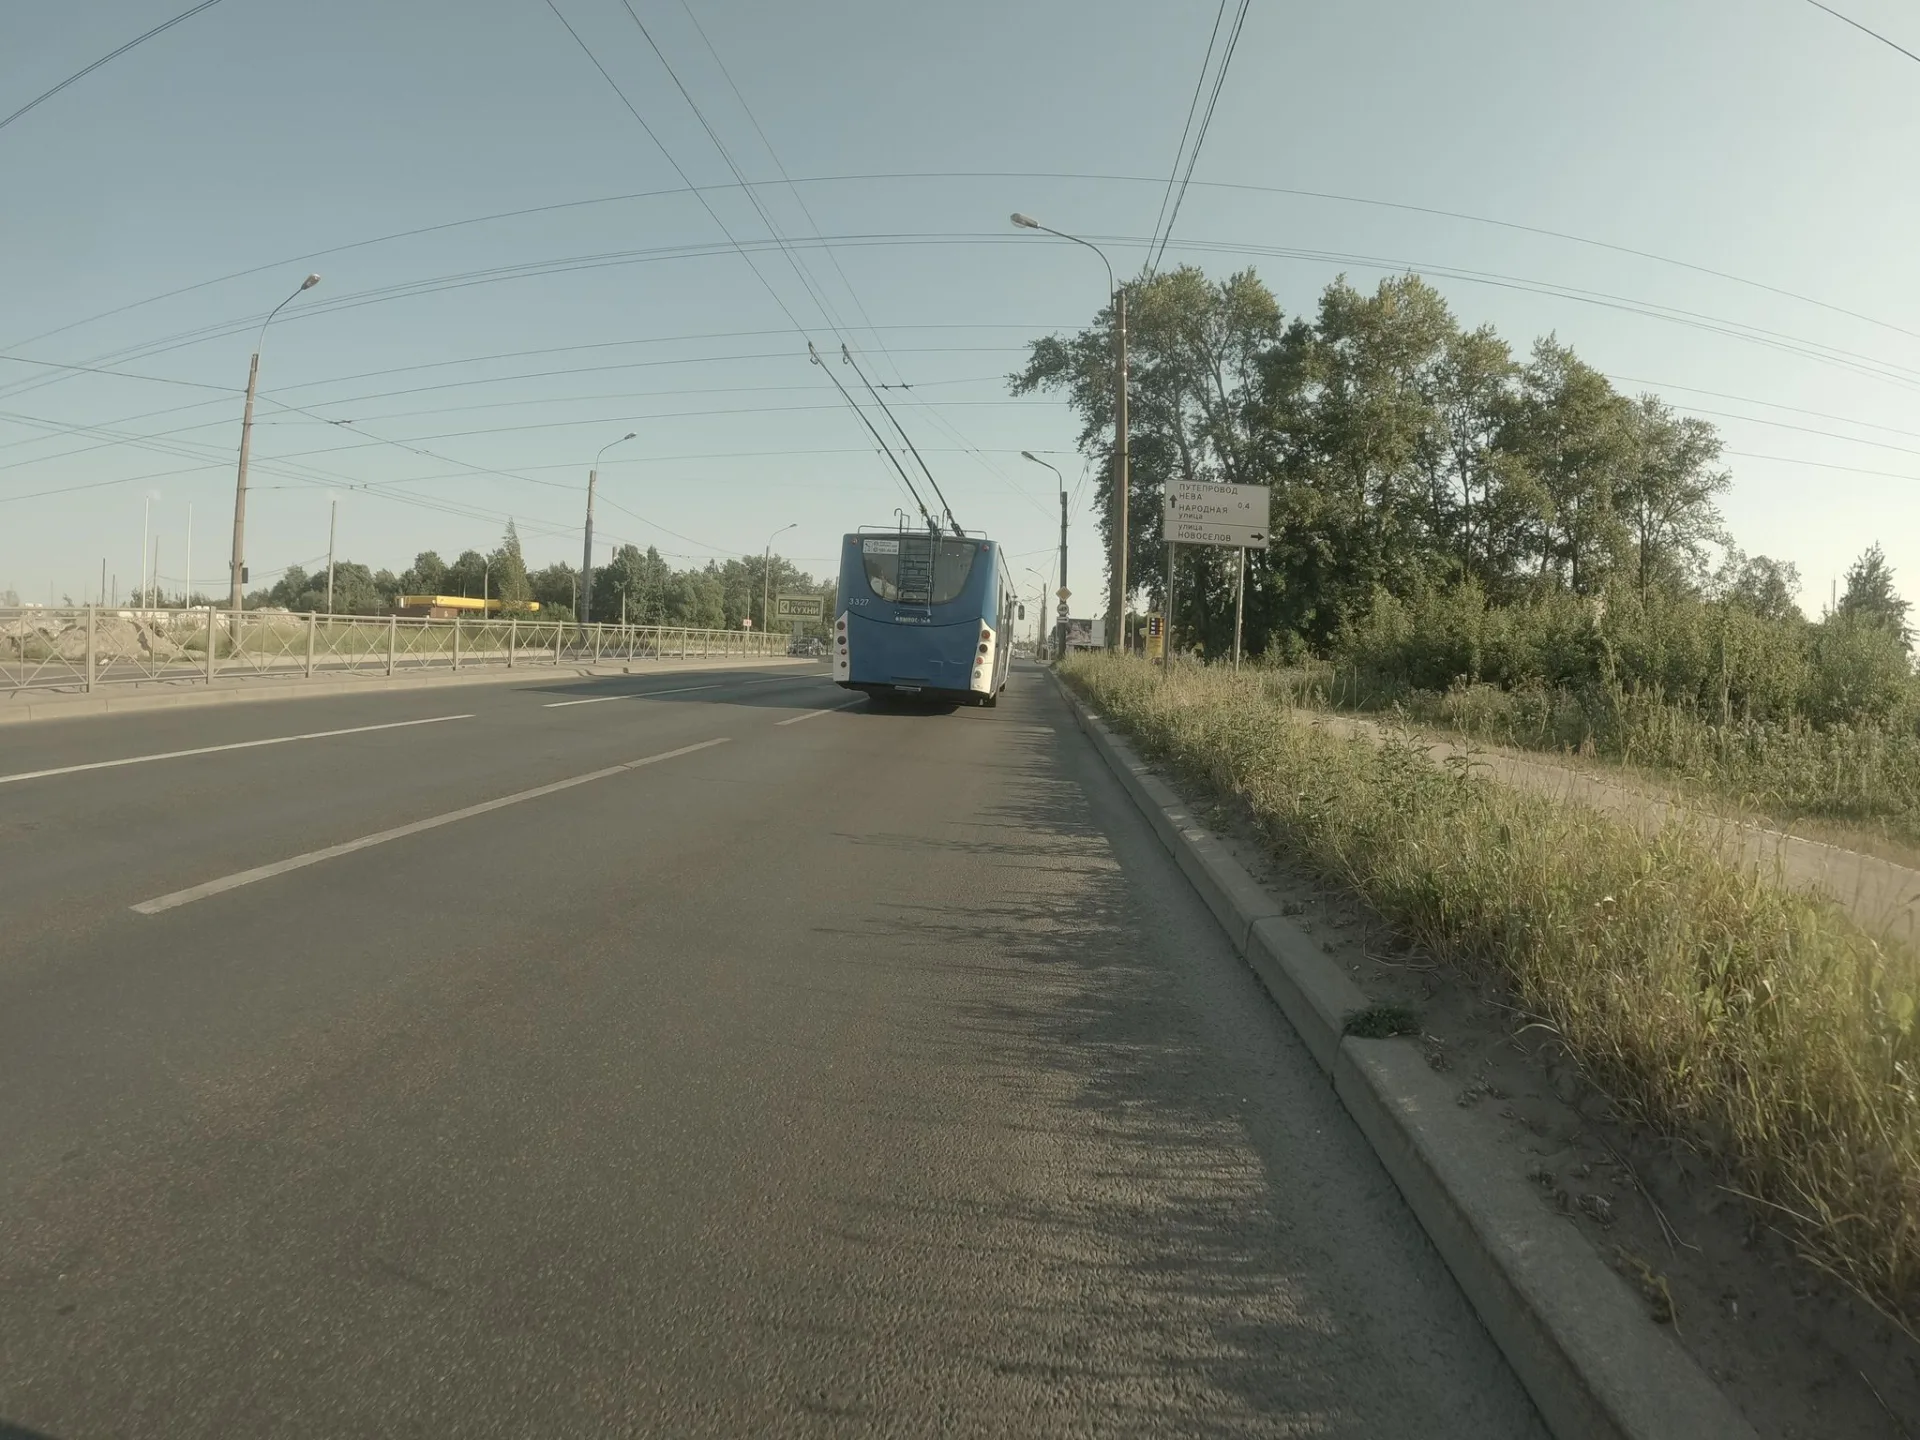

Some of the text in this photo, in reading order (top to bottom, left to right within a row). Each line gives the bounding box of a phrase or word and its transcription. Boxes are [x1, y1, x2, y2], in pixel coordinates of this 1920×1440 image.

[1179, 484, 1238, 495] ПУТЕПРОВОД
[1178, 504, 1228, 514] НАРОДНАЯ
[1178, 532, 1232, 542] НОВОСЕЛОВ
[848, 598, 870, 606] 3327
[790, 606, 819, 614] КУХНИ
